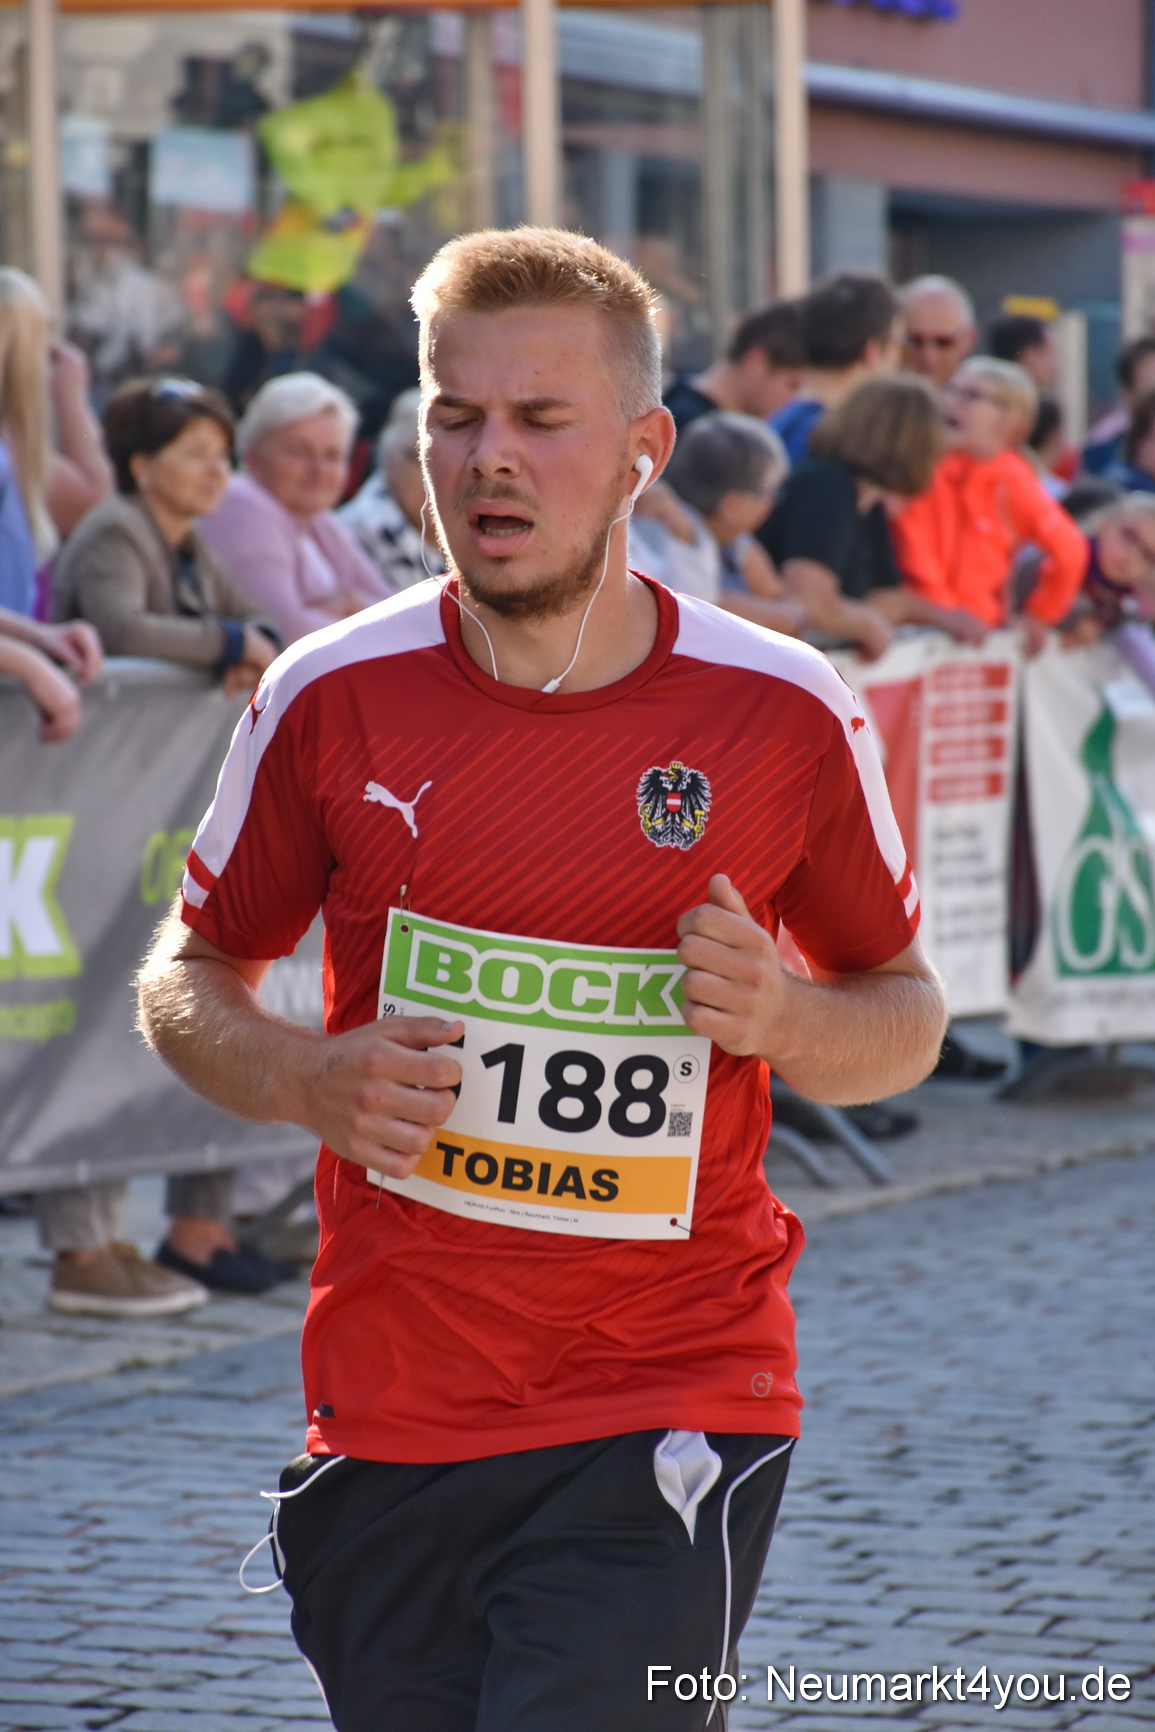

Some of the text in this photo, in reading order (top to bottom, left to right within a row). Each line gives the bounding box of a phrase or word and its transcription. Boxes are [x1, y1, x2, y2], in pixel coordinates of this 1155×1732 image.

[410, 935, 682, 1021] BOCK
[415, 1034, 669, 1138] 188
[680, 1061, 692, 1076] S
[436, 1141, 619, 1201] TOBIAS
